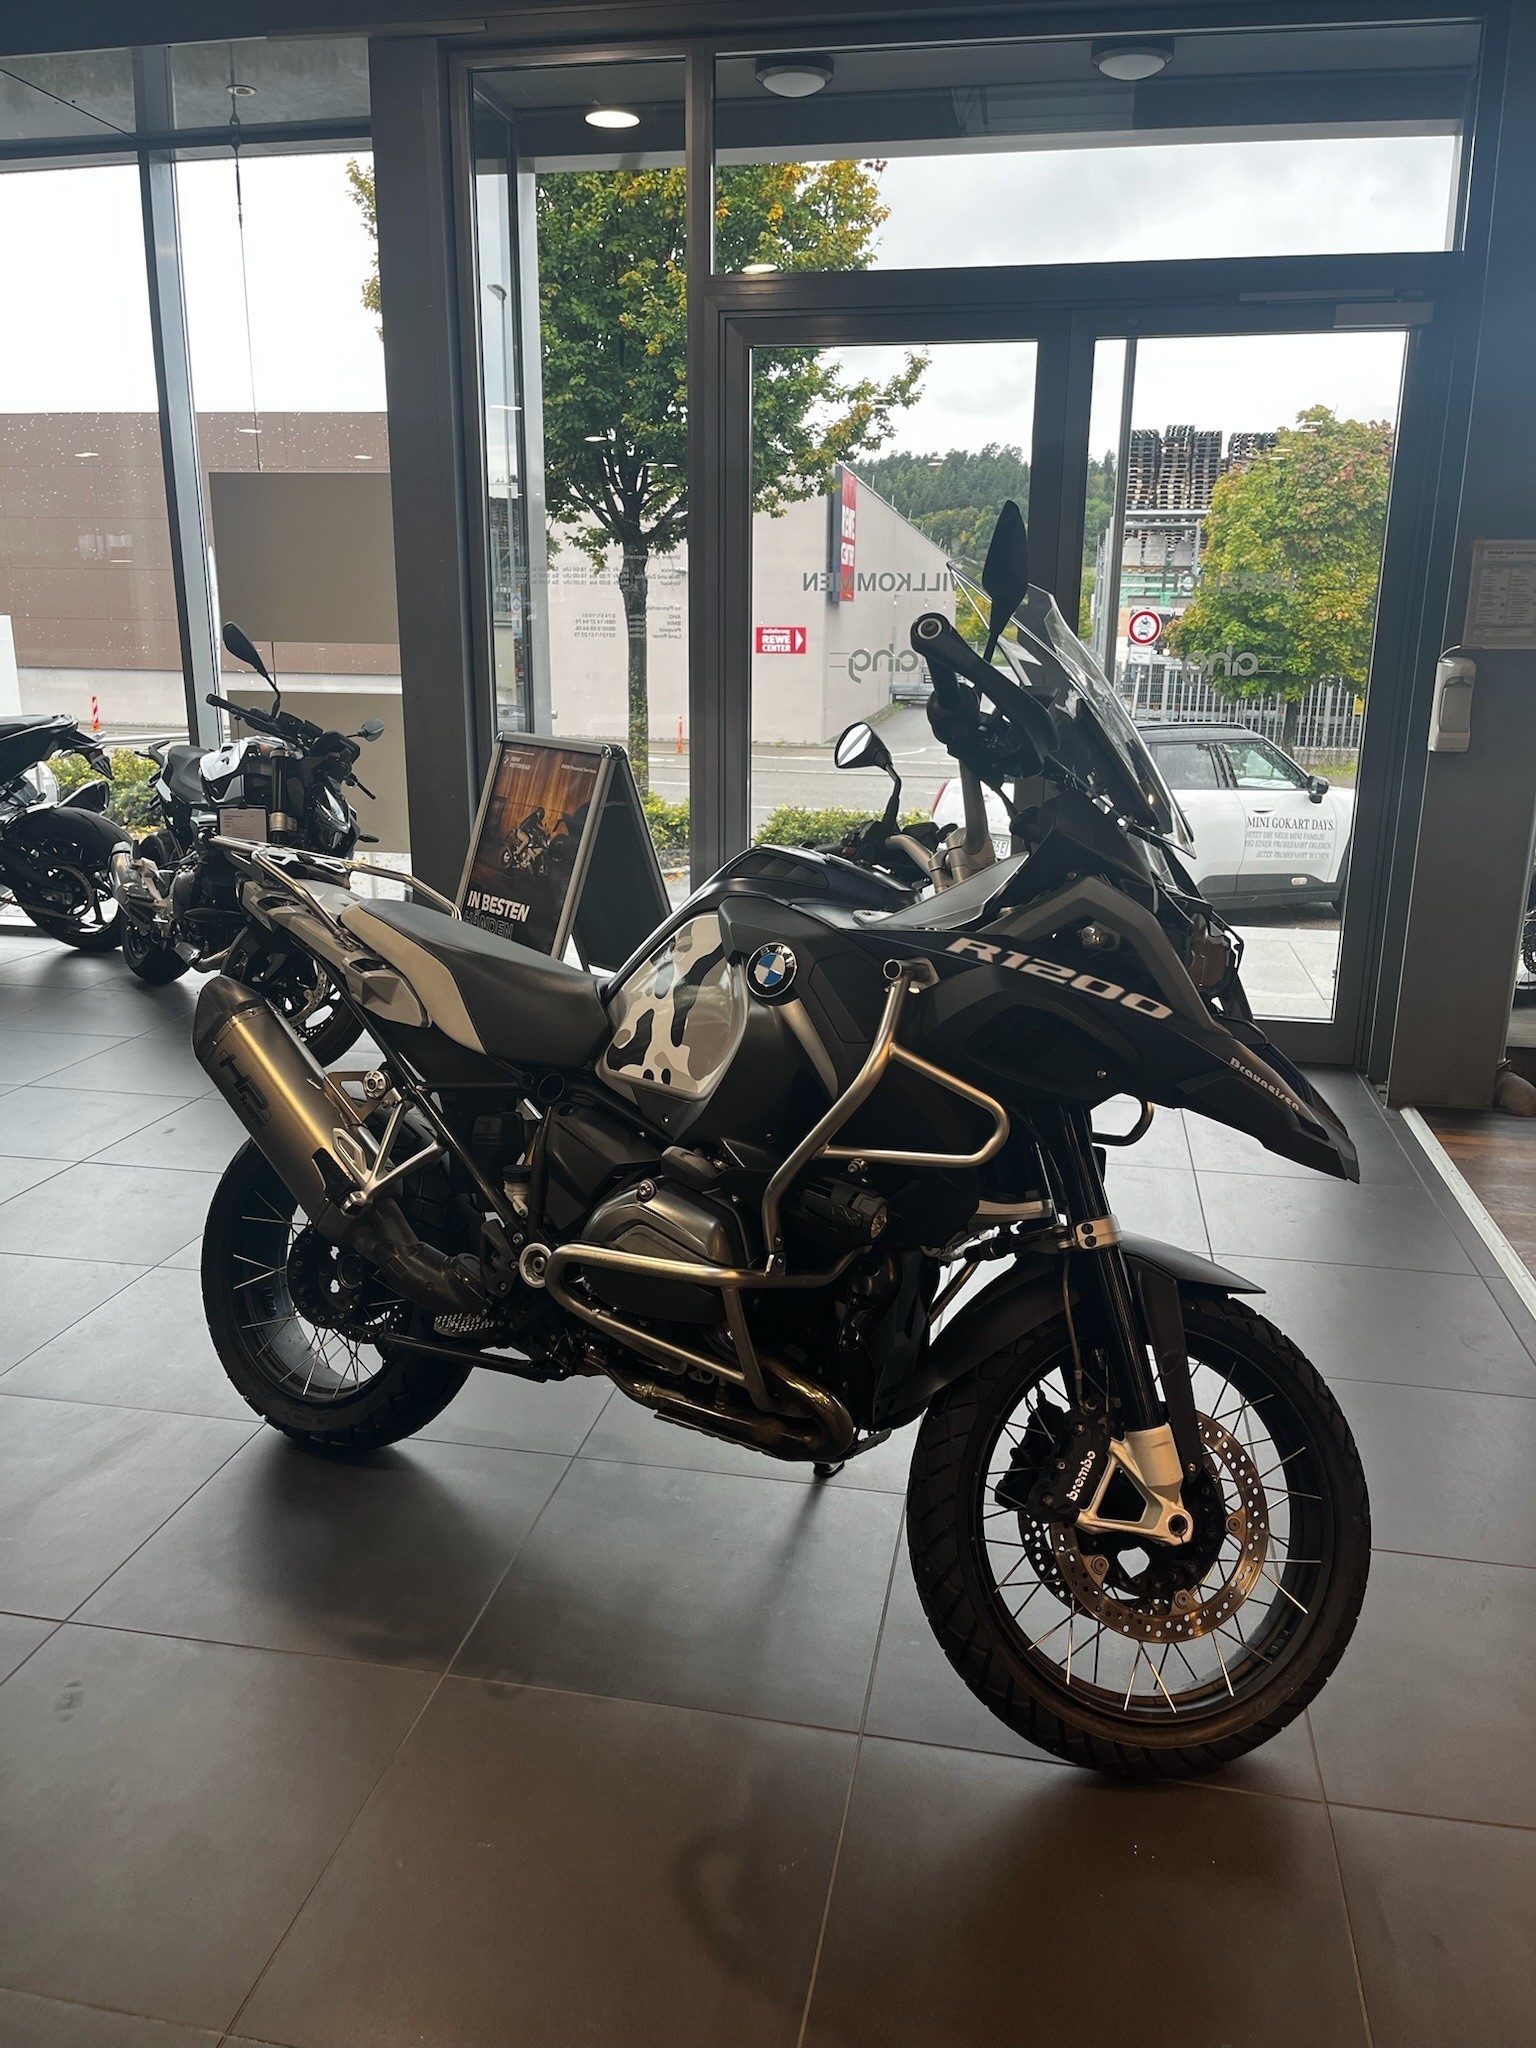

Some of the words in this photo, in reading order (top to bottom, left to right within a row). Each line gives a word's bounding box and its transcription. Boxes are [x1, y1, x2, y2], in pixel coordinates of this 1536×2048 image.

[761, 635, 791, 644] REWE
[761, 644, 791, 652] CENTER
[1247, 816, 1269, 828] MINI
[1271, 817, 1310, 830] GOKART
[1311, 819, 1335, 831] DAYS.
[1290, 832, 1302, 840] MINI
[1256, 850, 1273, 858] JETZT
[466, 890, 481, 909] IN
[481, 893, 530, 922] BESTEN
[945, 936, 1174, 1020] R1200
[1065, 1450, 1097, 1502] brembo
